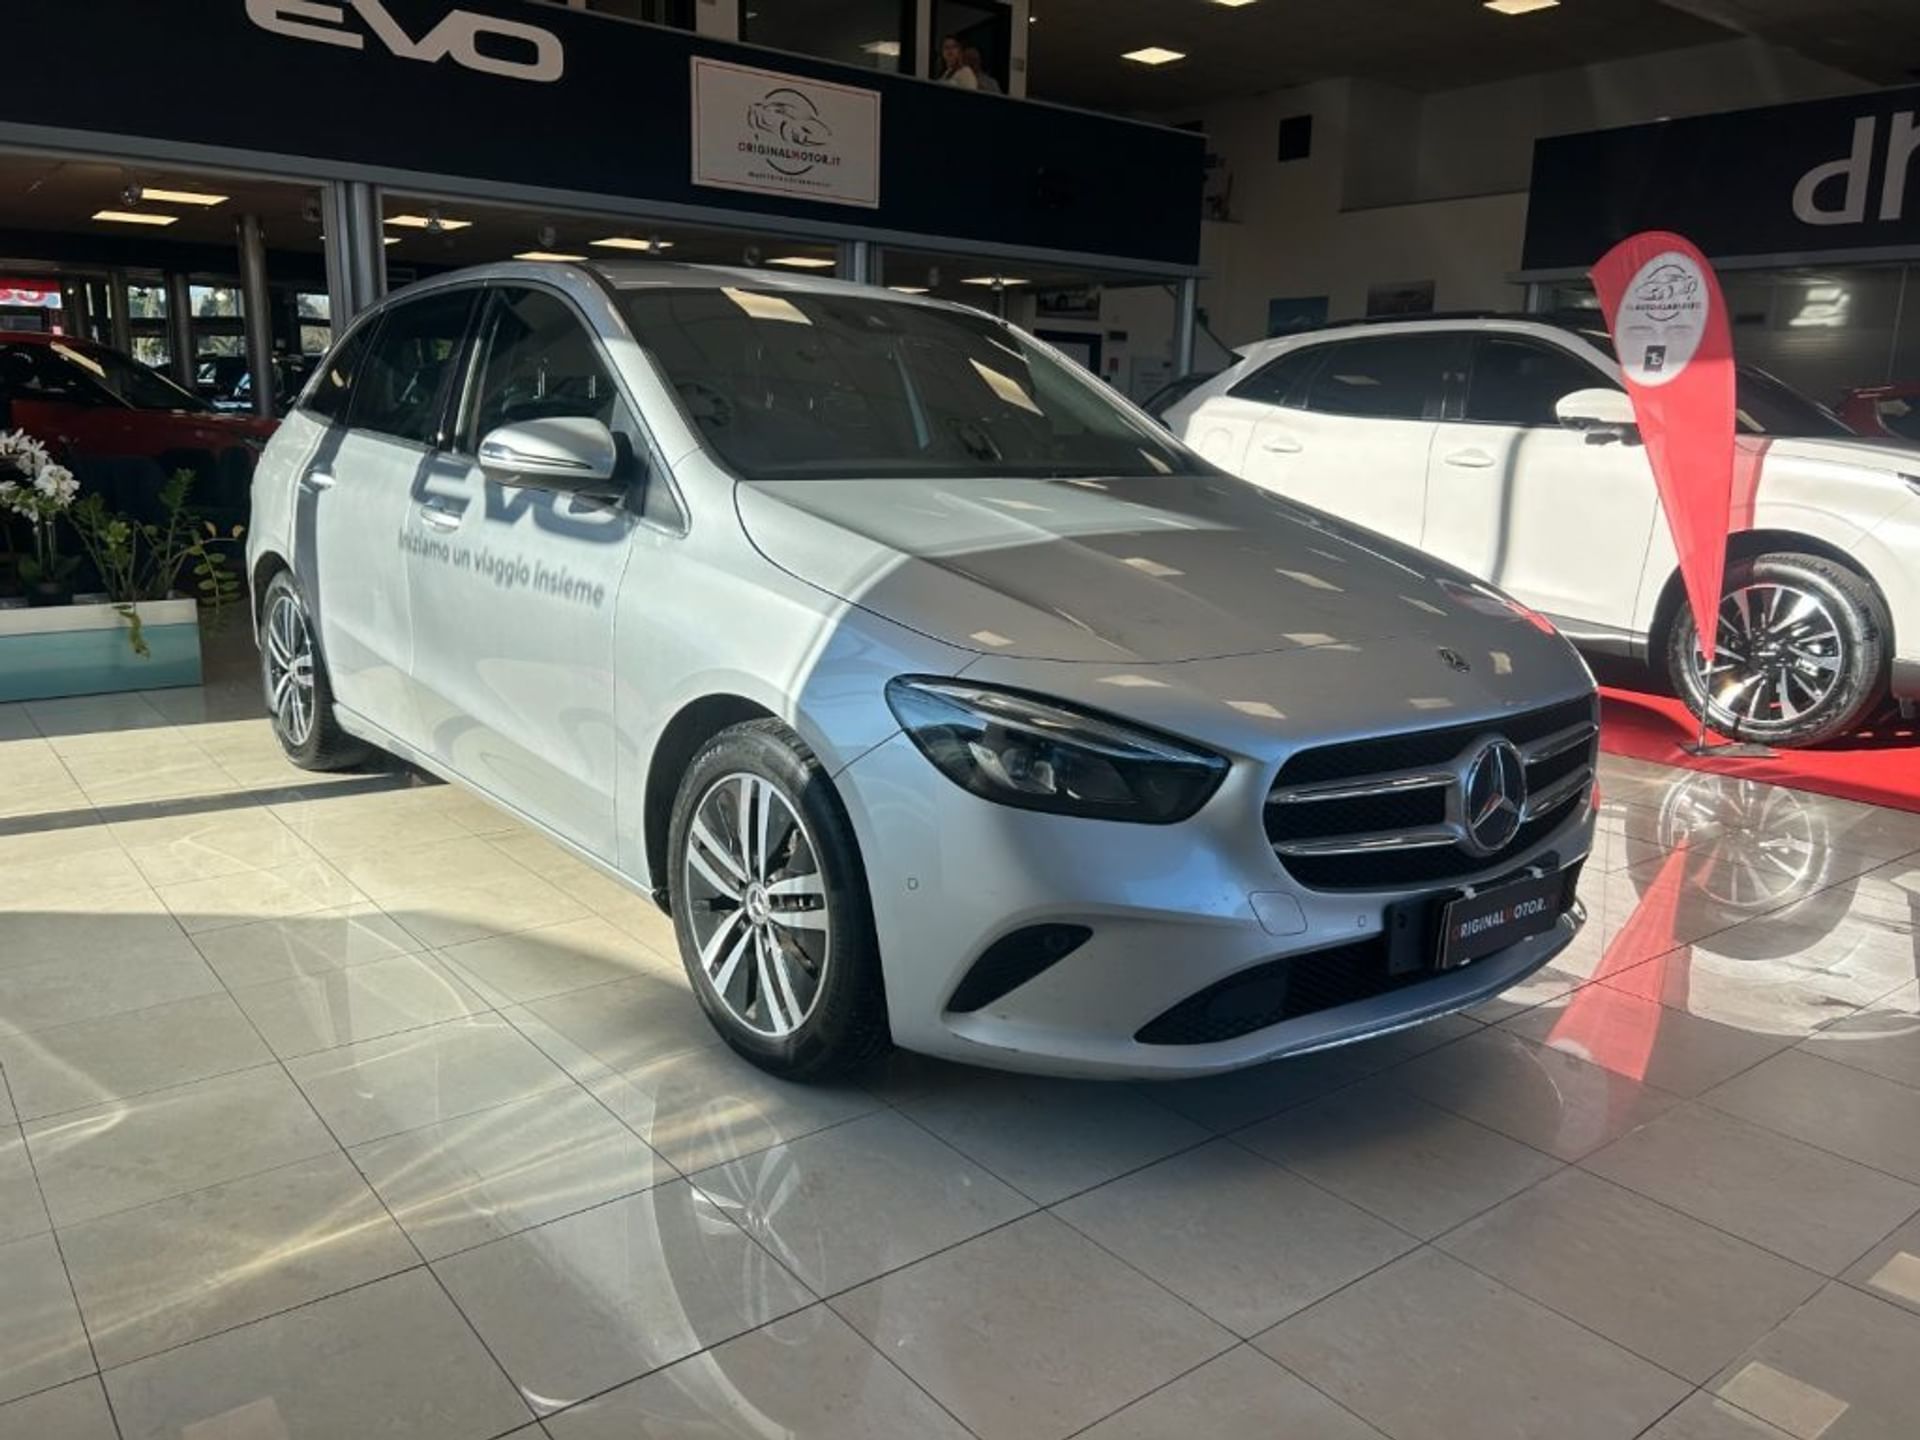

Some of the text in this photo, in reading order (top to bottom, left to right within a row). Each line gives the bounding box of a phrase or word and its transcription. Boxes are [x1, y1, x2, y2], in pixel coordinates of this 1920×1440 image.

[245, 0, 565, 83] EVO
[738, 141, 841, 166] ORIGINALMOTOR.IT
[399, 527, 605, 608] Iniziamo un viaggio insieme
